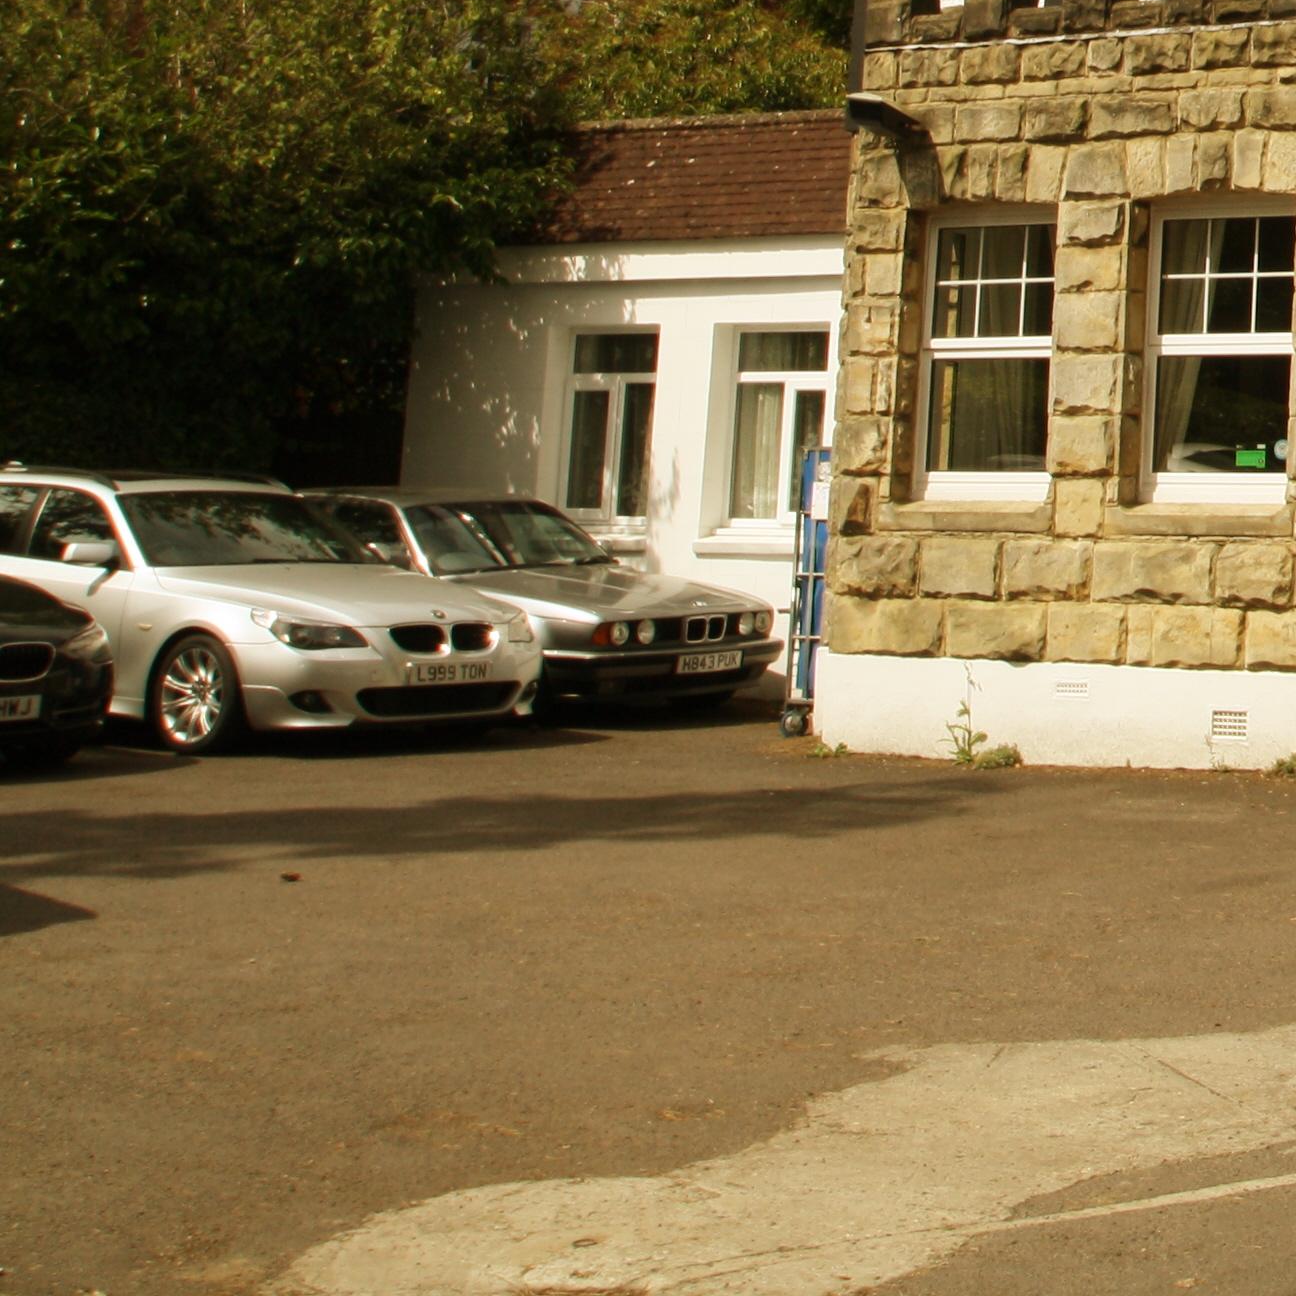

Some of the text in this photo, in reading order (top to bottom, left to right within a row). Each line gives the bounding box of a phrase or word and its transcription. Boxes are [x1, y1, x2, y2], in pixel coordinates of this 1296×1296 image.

[417, 663, 488, 681] L999 TON
[682, 655, 715, 672] H843
